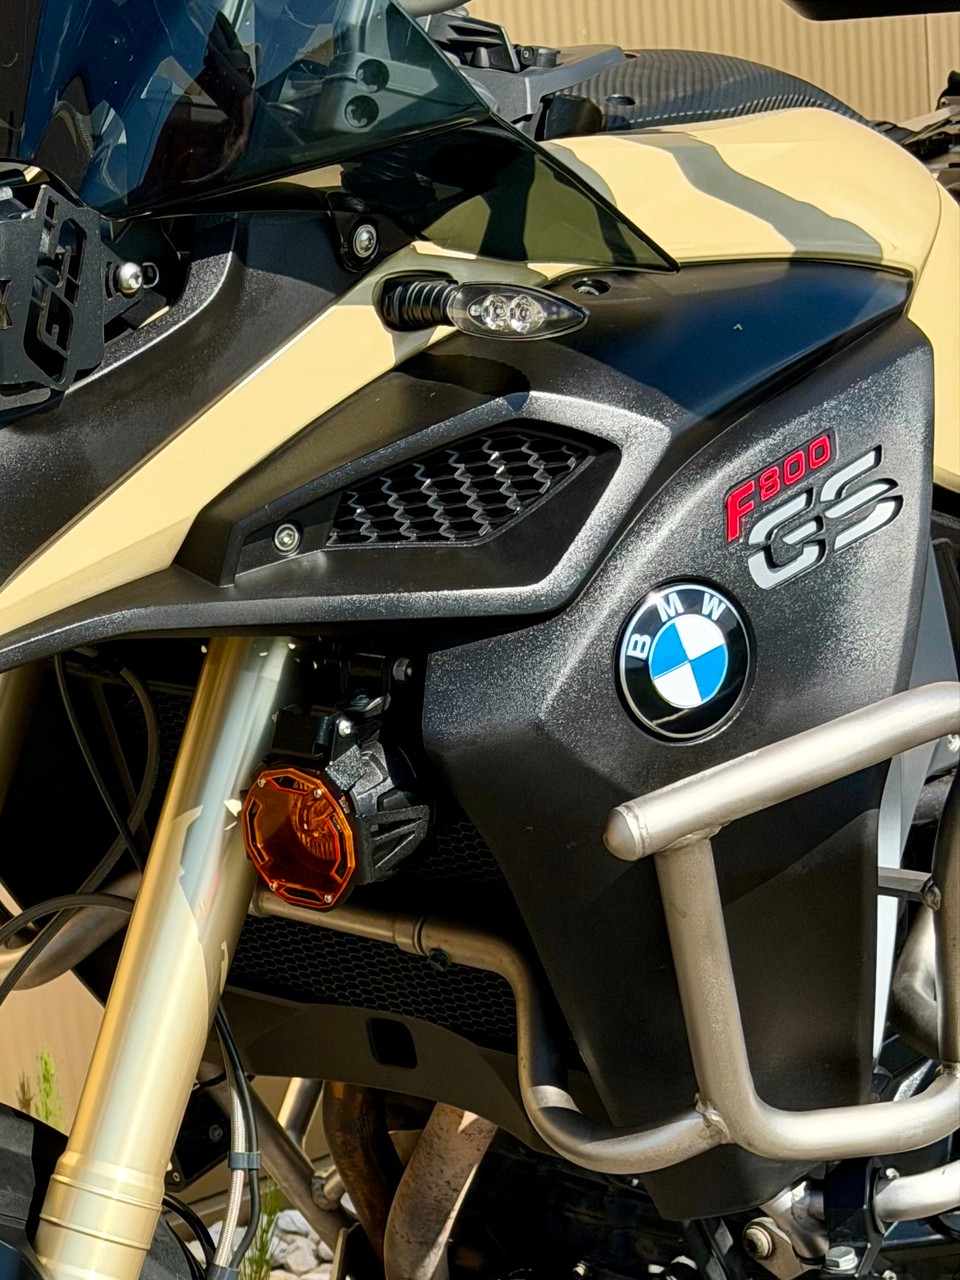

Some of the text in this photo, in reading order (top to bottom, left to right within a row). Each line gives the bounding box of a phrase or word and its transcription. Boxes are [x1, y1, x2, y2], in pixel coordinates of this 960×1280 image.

[725, 434, 832, 543] F800
[747, 445, 904, 591] GS
[627, 592, 727, 661] BMW
